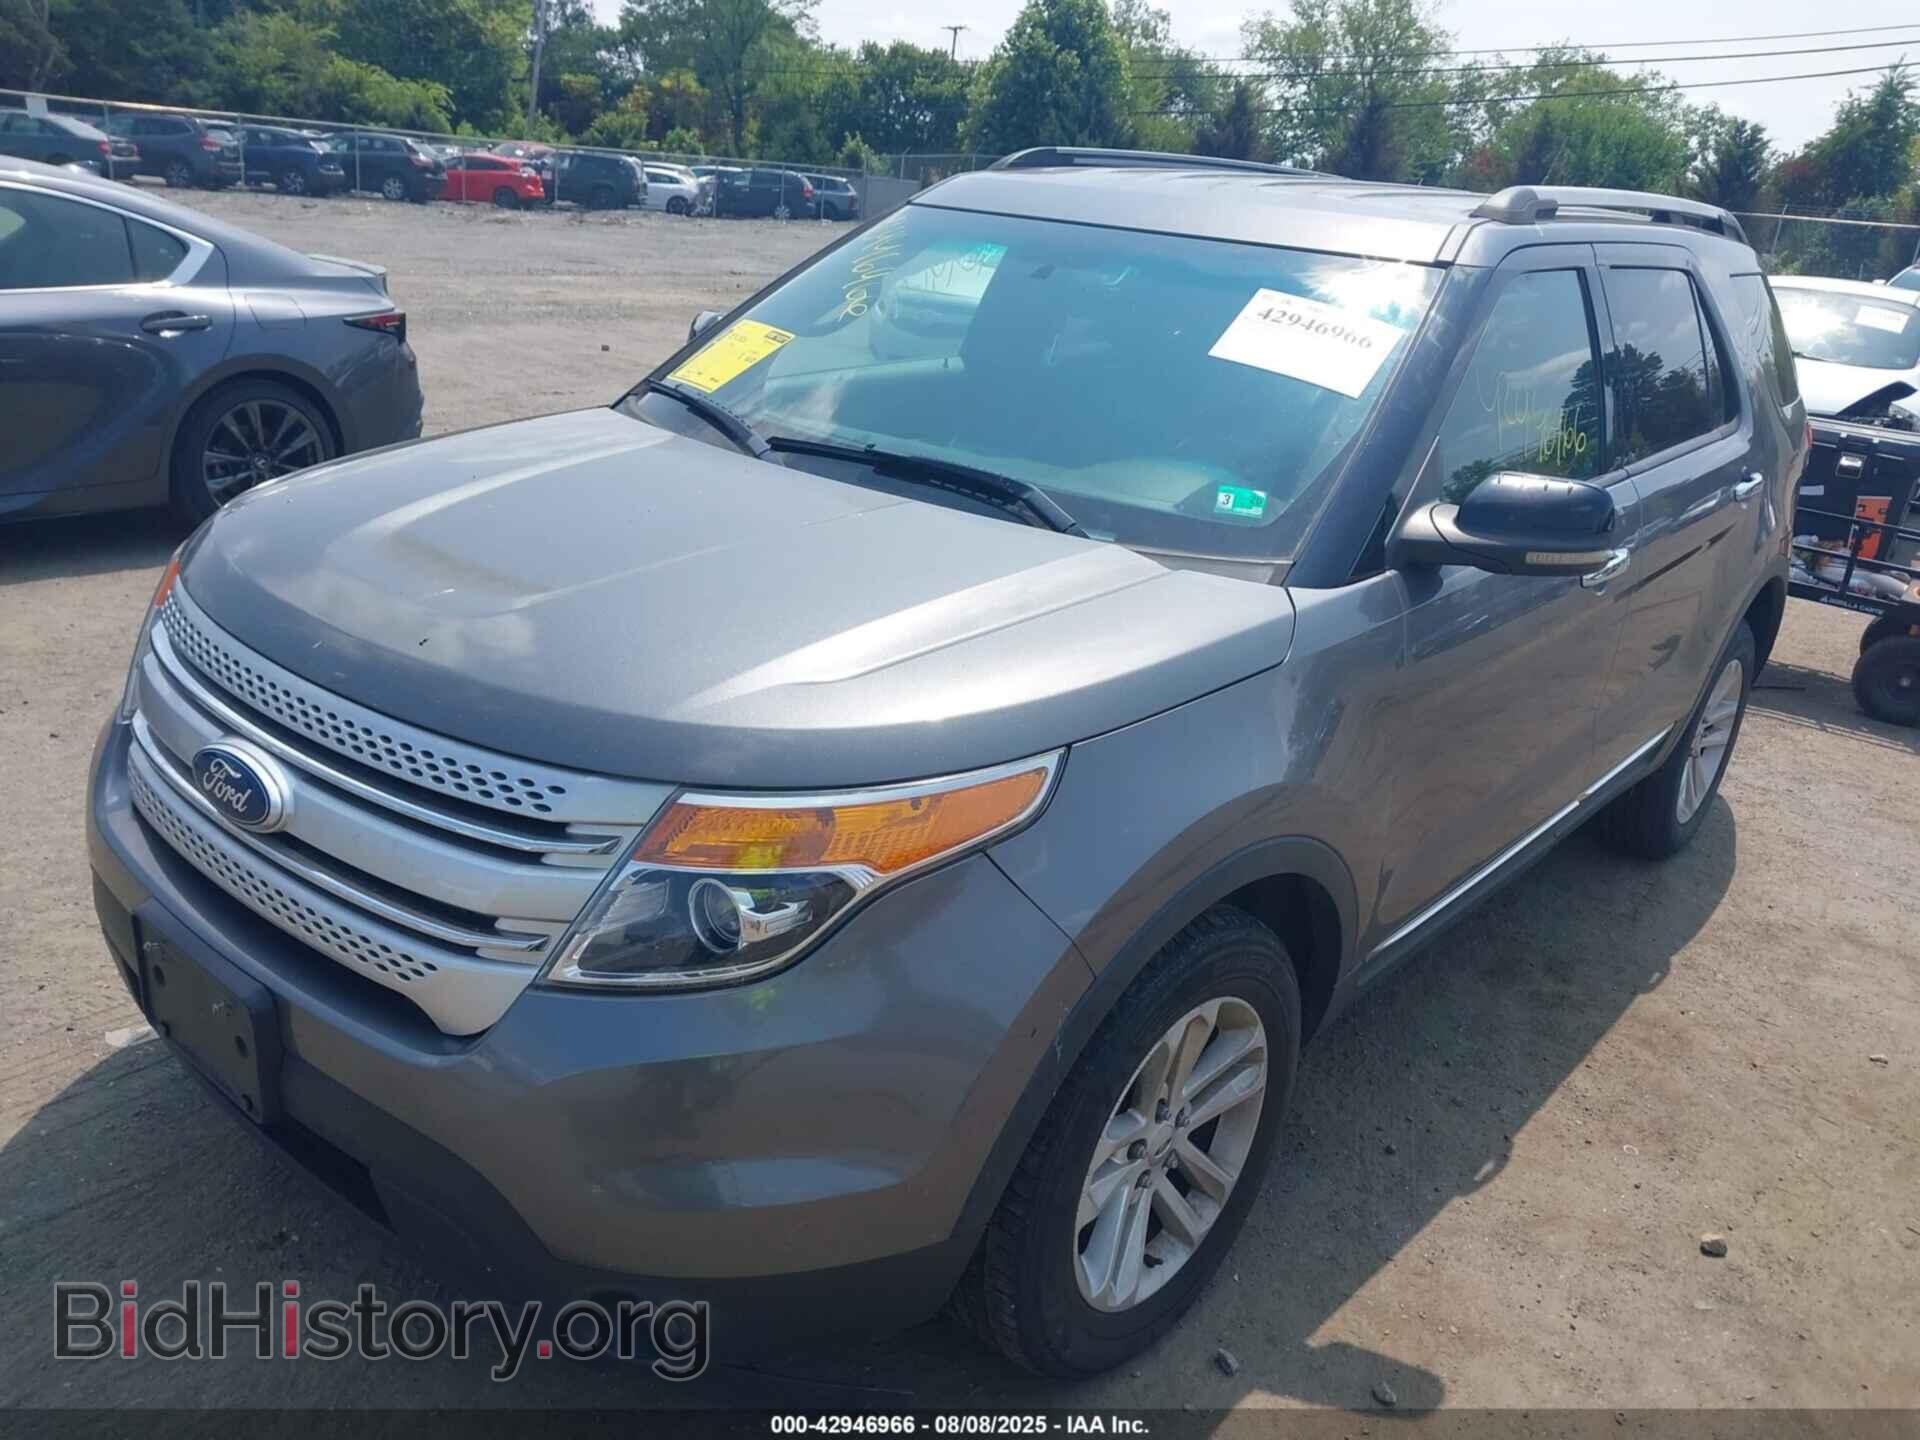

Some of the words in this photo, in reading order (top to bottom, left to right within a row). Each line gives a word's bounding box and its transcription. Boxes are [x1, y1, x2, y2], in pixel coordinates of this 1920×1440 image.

[1256, 306, 1373, 350] 42946966
[1221, 494, 1231, 506] 3
[203, 757, 251, 813] Ford
